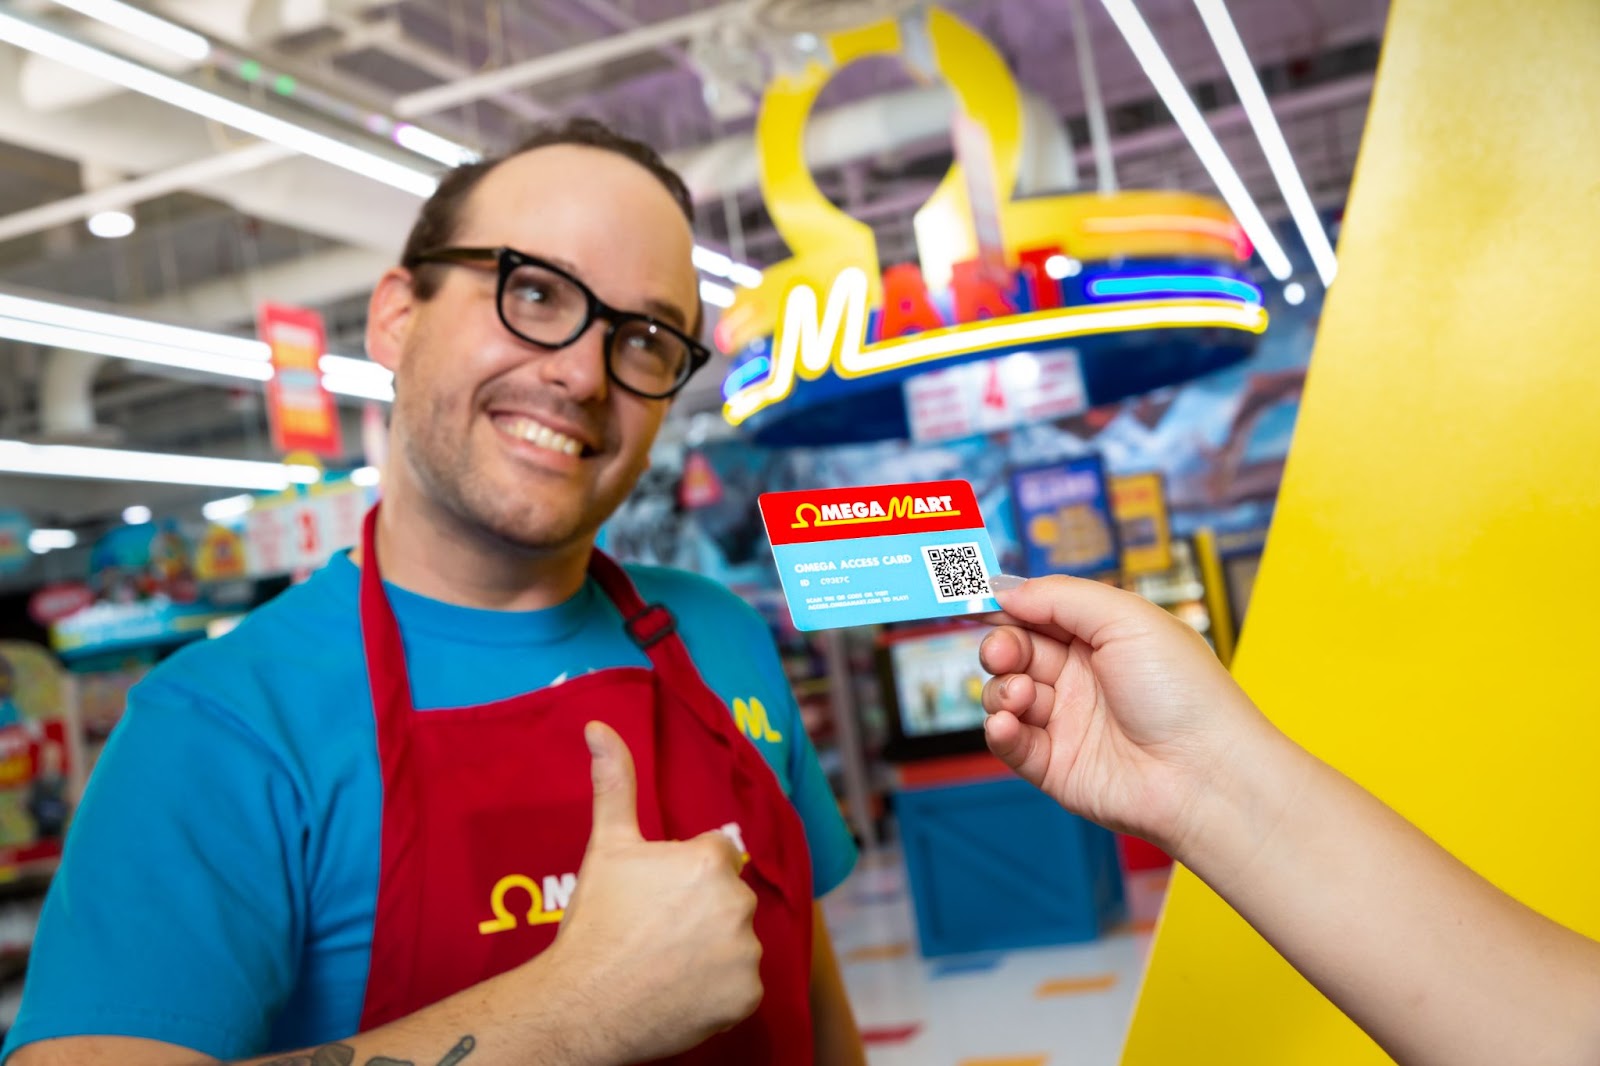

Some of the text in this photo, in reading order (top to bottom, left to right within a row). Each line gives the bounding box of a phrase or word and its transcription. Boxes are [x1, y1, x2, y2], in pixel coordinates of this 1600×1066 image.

[887, 495, 961, 520] MART
[794, 554, 912, 573] OMEGA ACCESS CARD
[800, 579, 810, 587] ID
